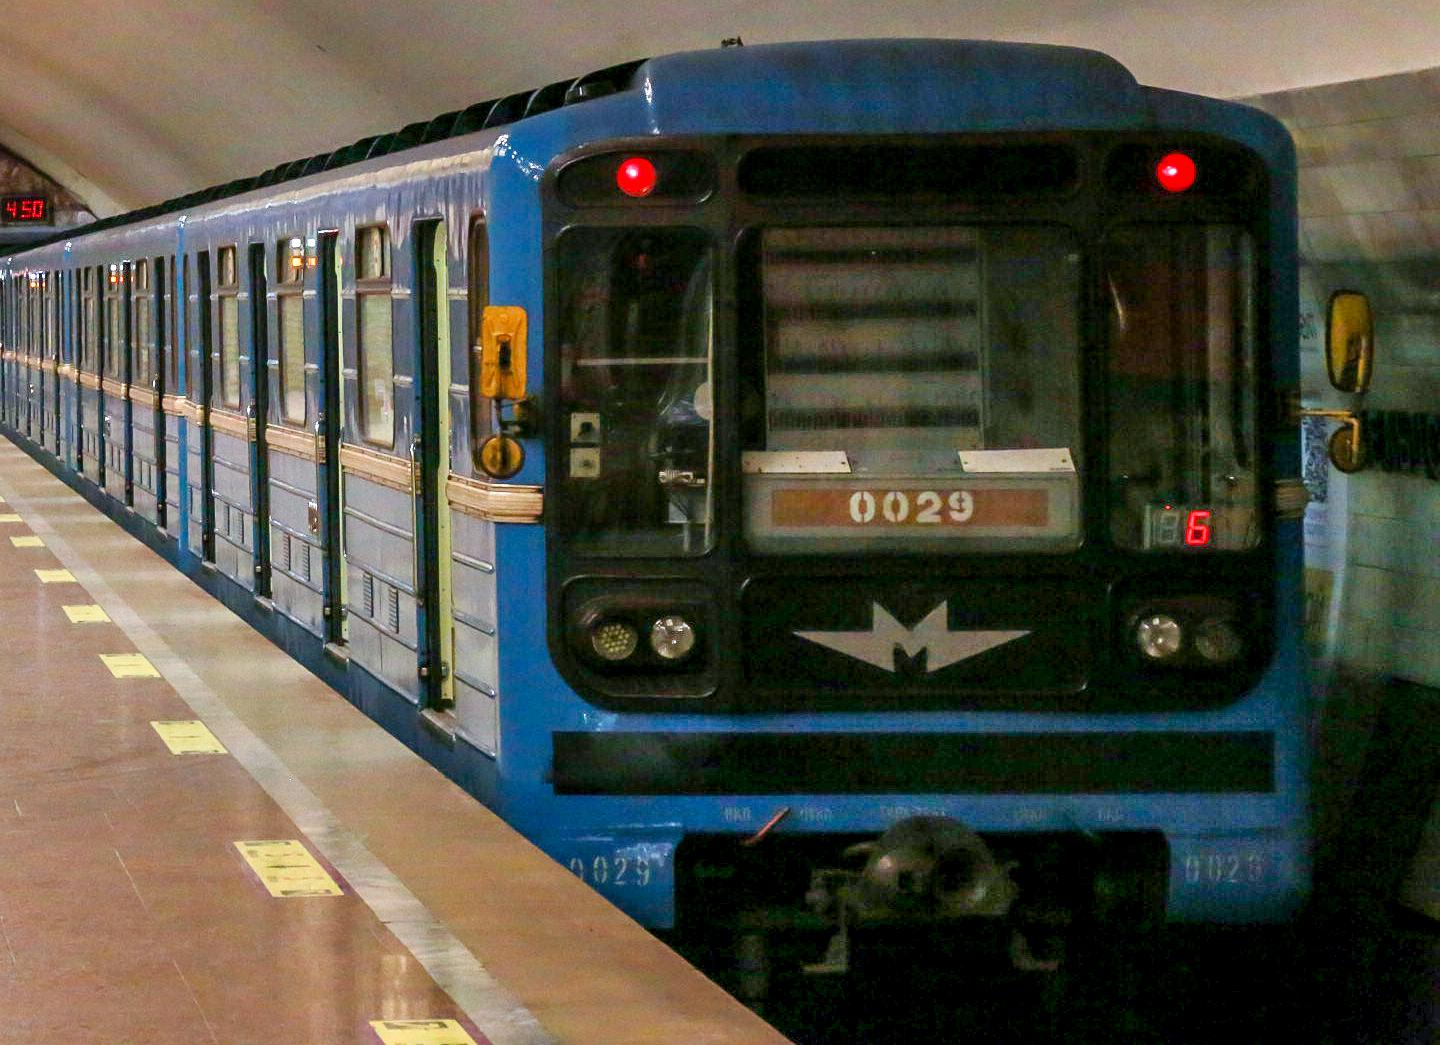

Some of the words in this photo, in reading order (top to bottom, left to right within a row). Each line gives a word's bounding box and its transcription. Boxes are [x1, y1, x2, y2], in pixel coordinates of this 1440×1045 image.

[850, 491, 974, 523] 0029
[1186, 510, 1211, 546] 6
[570, 856, 650, 886] 0029
